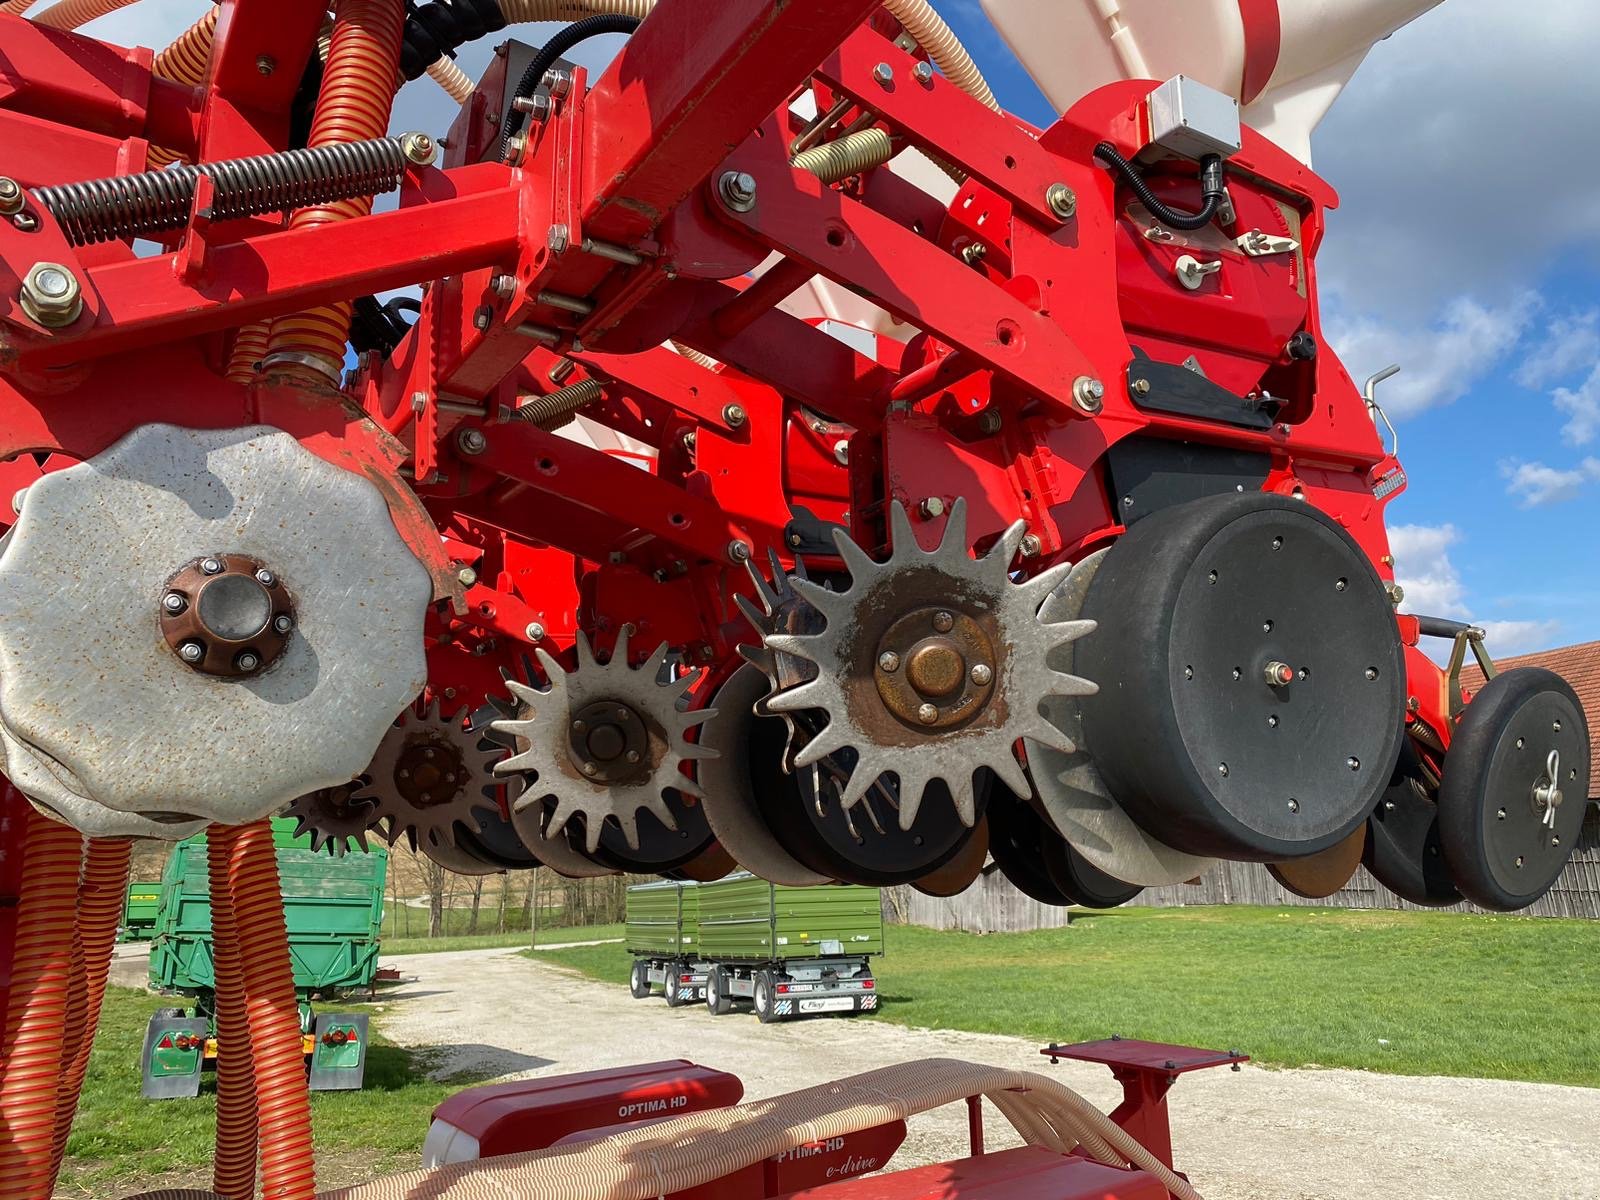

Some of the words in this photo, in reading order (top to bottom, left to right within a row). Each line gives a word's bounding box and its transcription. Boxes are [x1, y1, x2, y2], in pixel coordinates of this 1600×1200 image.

[618, 1099, 667, 1117] OPTIMA
[670, 1095, 687, 1109] HD
[771, 1145, 822, 1163] PTIMA
[825, 1136, 845, 1152] HD
[826, 1155, 878, 1178] e-drive
